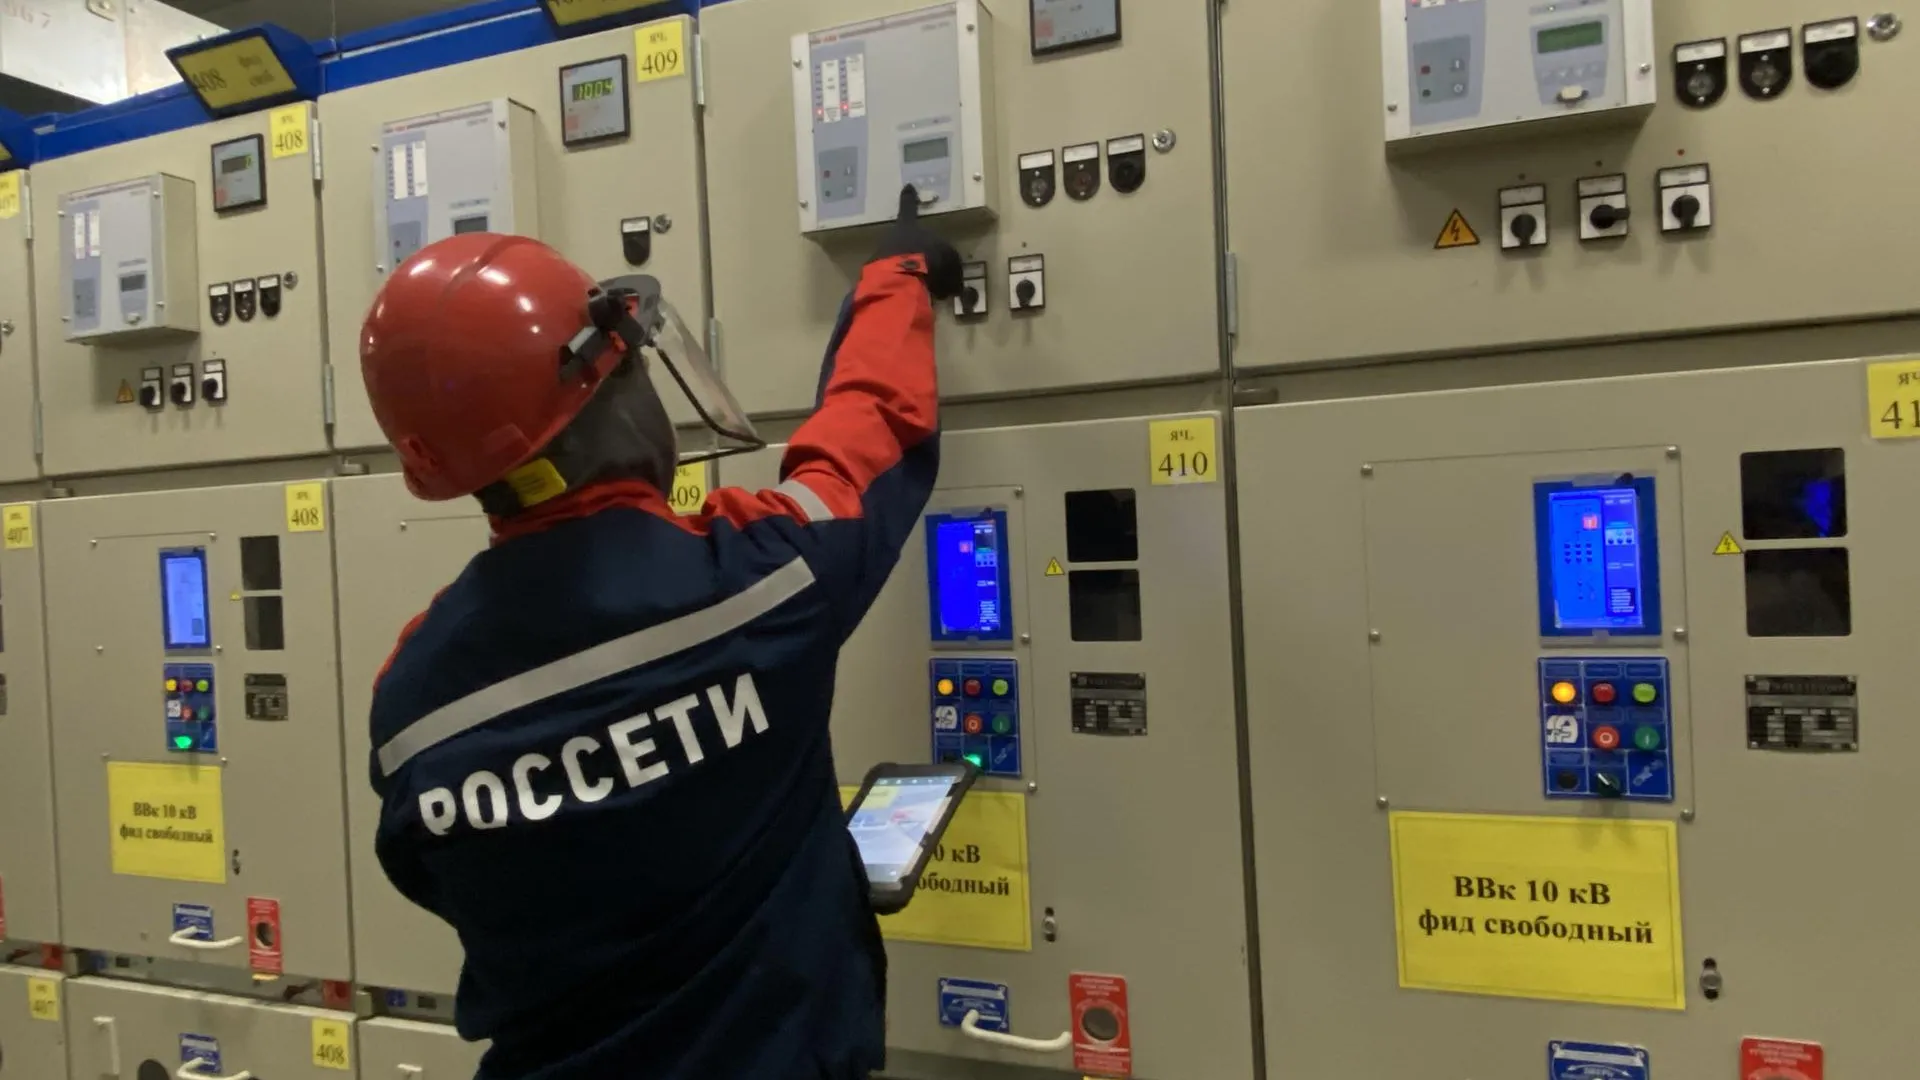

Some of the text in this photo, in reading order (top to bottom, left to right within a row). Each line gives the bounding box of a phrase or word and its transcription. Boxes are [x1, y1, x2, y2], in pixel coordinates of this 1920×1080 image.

[641, 48, 678, 75] 409
[274, 130, 304, 153] 408
[1158, 451, 1208, 477] 410
[291, 507, 319, 526] 408
[418, 672, 770, 837] РОССЕТИ
[133, 801, 198, 820] ВВк 10 кВ
[120, 824, 213, 843] фид свободный
[932, 844, 981, 864] 0 кВ
[916, 872, 1010, 896] ободный
[1454, 876, 1612, 905] ВВк 10 кВ
[1418, 909, 1654, 944] фид свободный
[316, 1043, 345, 1065] 408
